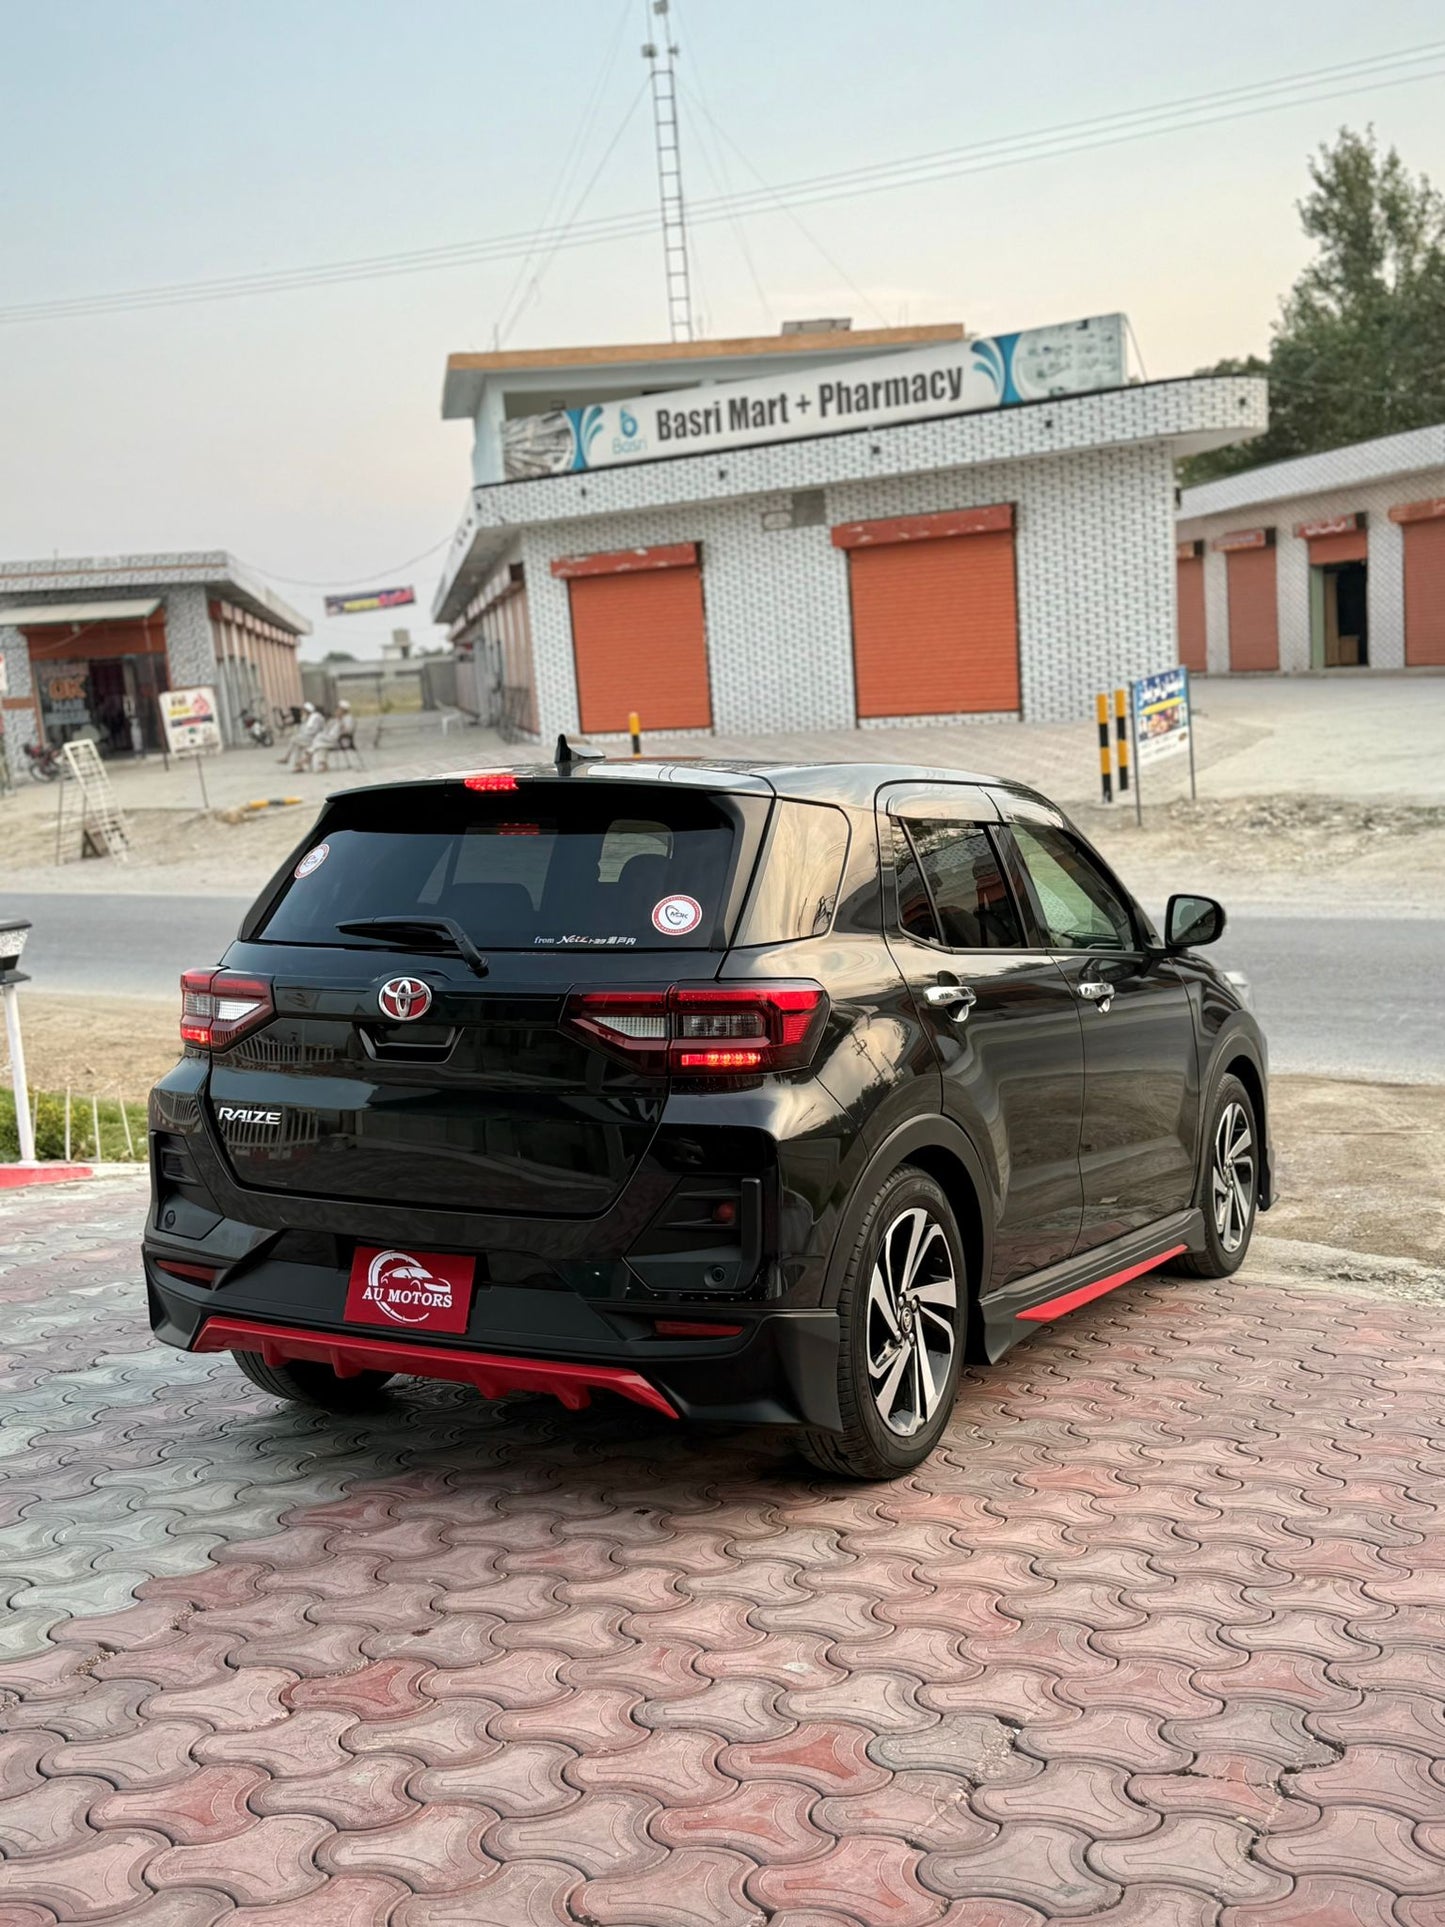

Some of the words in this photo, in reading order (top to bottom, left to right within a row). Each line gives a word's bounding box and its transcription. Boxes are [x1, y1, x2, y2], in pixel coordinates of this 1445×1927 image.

[656, 401, 722, 441] Basri
[728, 392, 790, 431] Mart
[819, 366, 963, 418] Pharmacy
[612, 436, 648, 455] Basri
[534, 936, 555, 944] from
[219, 1107, 282, 1125] RAIZE
[362, 1287, 384, 1301] AU
[387, 1289, 453, 1308] MOTORS
